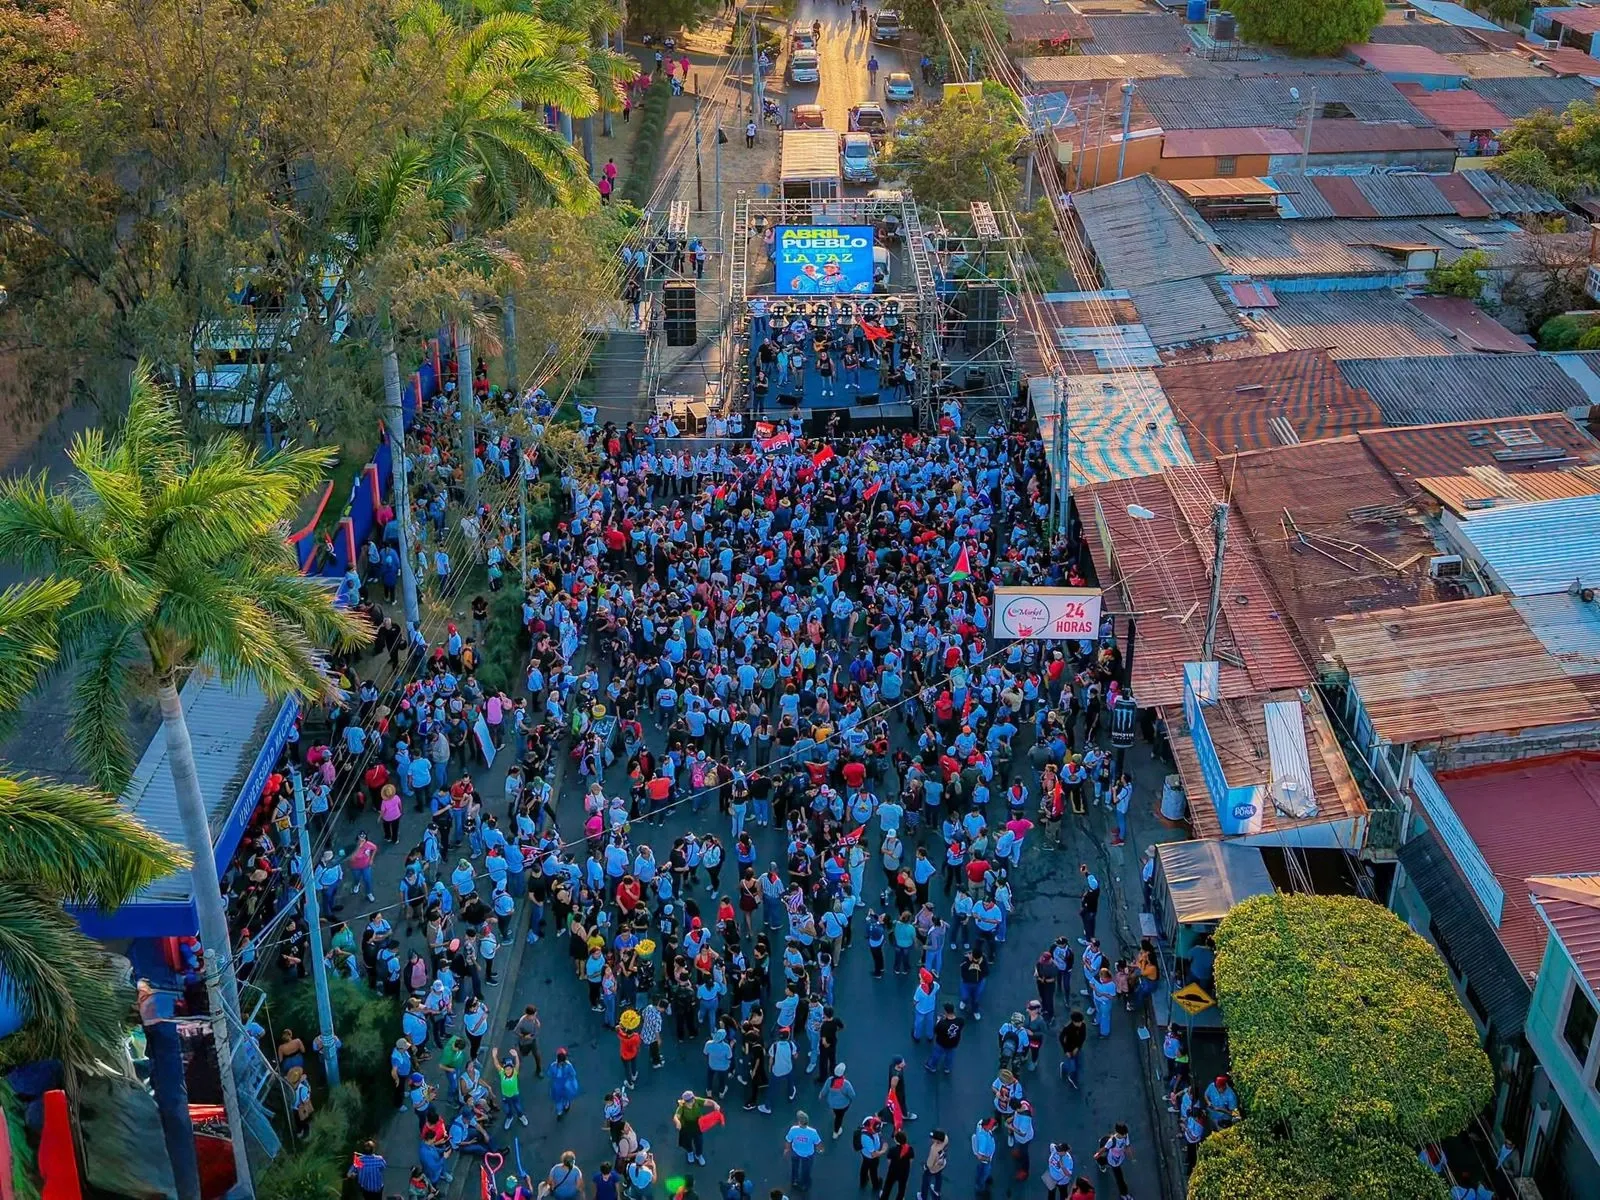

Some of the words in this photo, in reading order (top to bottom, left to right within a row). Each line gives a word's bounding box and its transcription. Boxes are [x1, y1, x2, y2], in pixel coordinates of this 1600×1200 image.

[782, 229, 850, 240] ABRIL,
[782, 238, 868, 249] PUEBLO
[783, 253, 810, 263] LA
[815, 253, 853, 263] PAZ
[1065, 603, 1085, 618] 24
[1056, 621, 1092, 633] HORAS
[239, 747, 276, 826] UNIVERSIDAD
